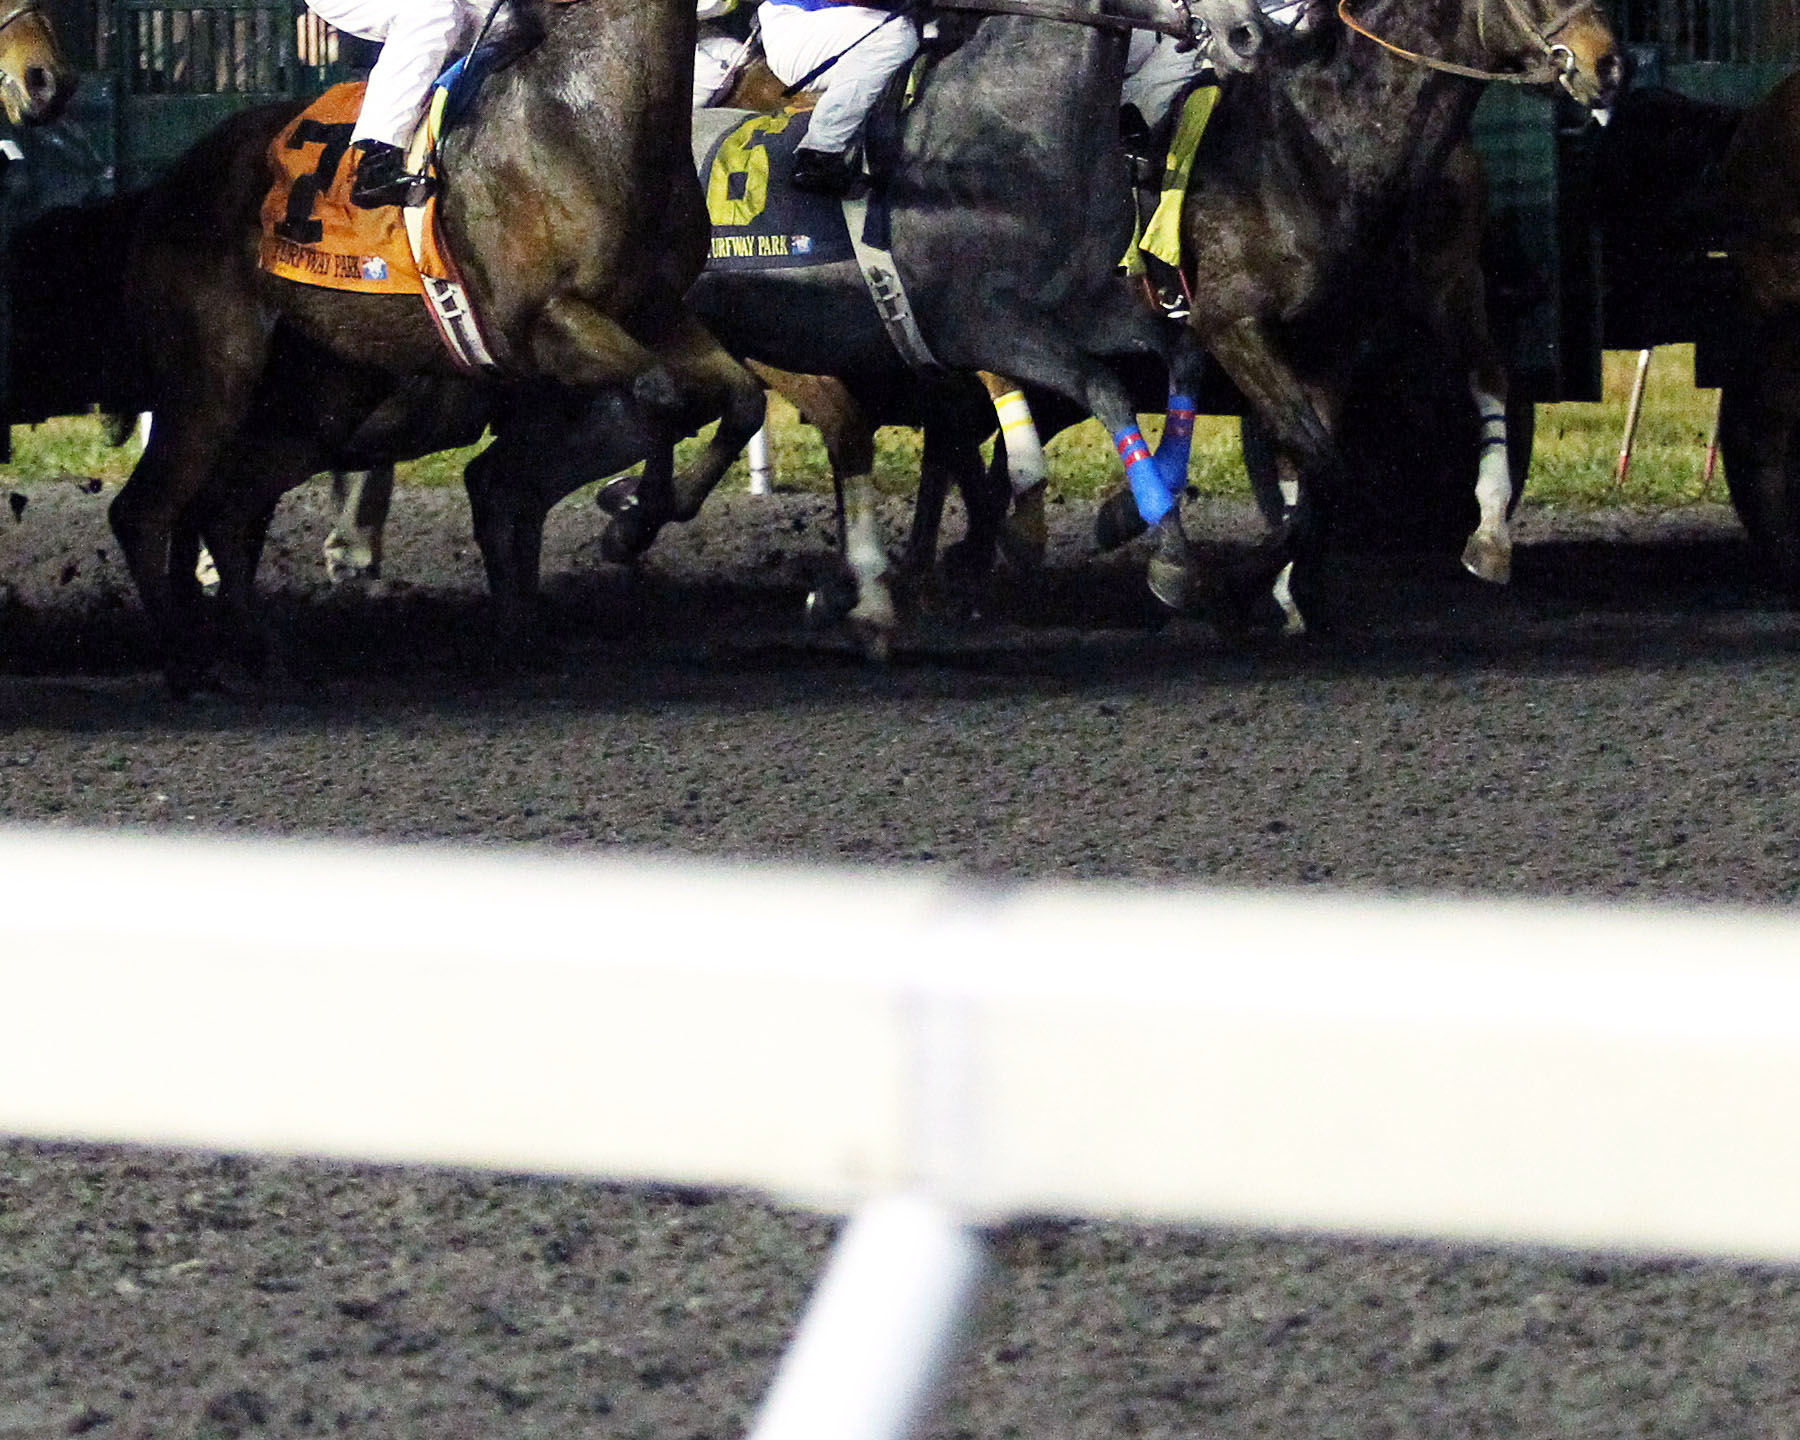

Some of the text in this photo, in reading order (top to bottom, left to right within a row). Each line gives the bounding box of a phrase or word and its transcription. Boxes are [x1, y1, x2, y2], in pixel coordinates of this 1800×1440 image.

[274, 119, 356, 244] 7
[706, 113, 791, 226] 6
[757, 234, 789, 256] PARK
